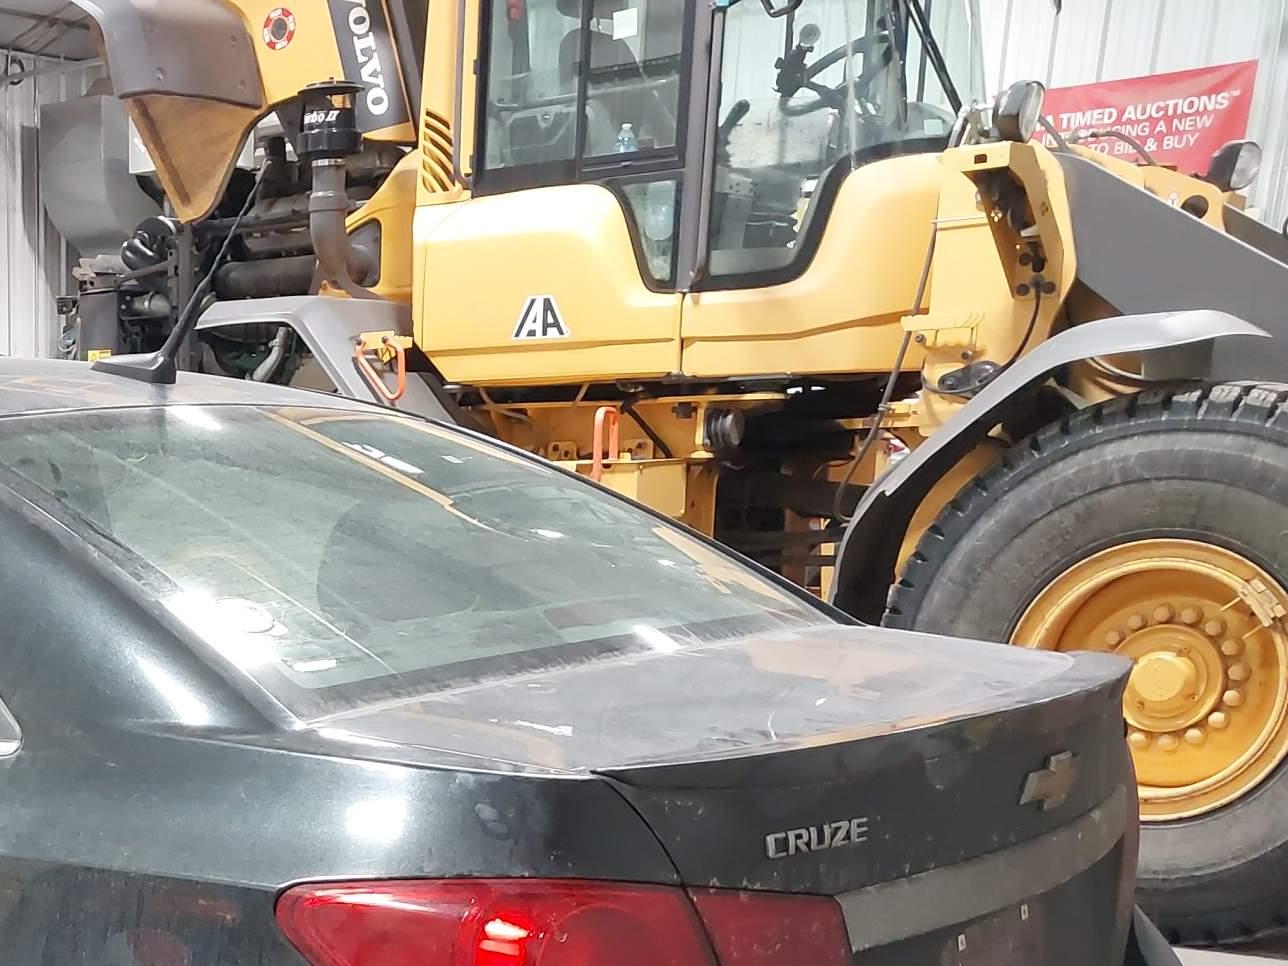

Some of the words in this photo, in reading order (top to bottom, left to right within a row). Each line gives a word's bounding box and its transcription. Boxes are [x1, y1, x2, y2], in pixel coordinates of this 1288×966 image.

[344, 0, 389, 116] OLVO
[1059, 109, 1117, 129] TIMED
[1122, 92, 1231, 122] AUCTIONS
[1155, 121, 1167, 133] A
[1172, 114, 1215, 131] NEW
[1144, 138, 1157, 152] &
[1163, 132, 1200, 150] BUY
[765, 817, 869, 859] CRUZE
